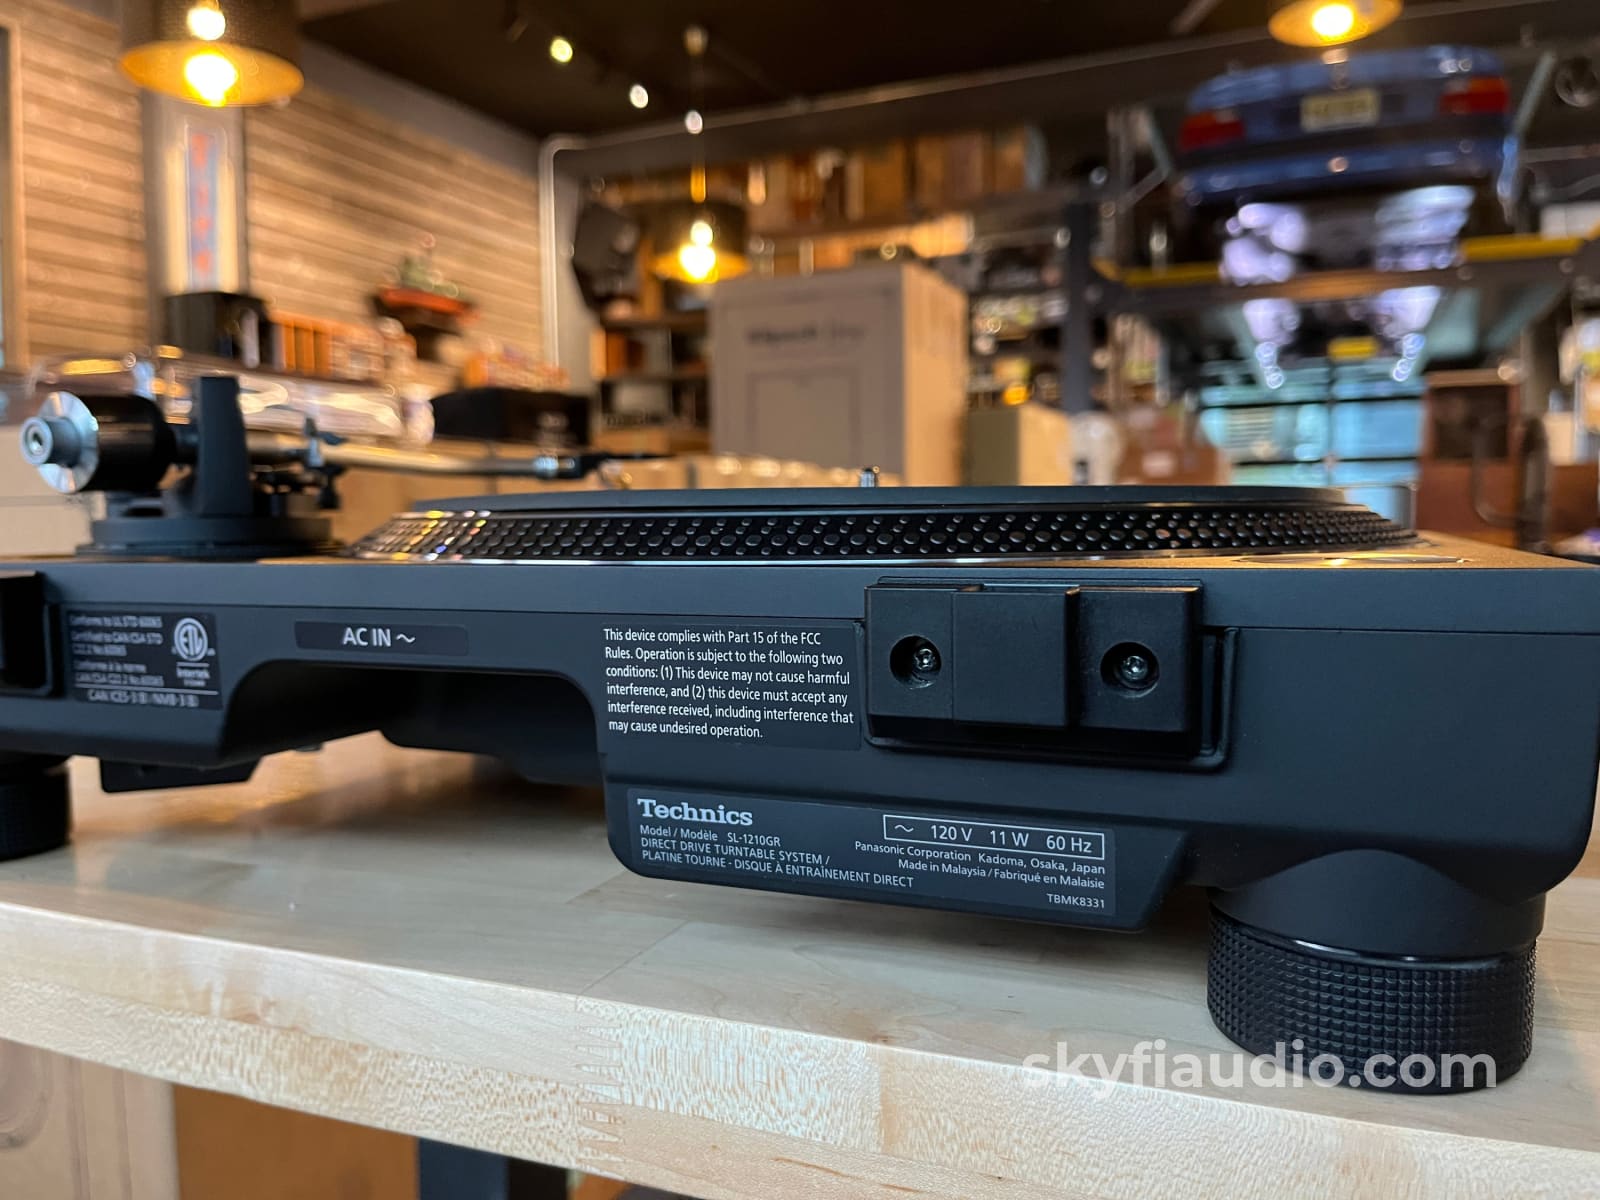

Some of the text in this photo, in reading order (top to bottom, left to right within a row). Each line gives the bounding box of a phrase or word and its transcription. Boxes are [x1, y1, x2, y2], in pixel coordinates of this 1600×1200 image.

[343, 627, 391, 647] AC IN
[604, 628, 821, 645] This device complies with Part 15 of the FCC
[605, 647, 843, 667] Rules. Operation is subject to the following two
[606, 665, 850, 684] conditions: (1) This device may not cause harmful
[607, 683, 847, 706] interference, and (2) this device must accept any
[608, 701, 854, 723] interference received, including interference that
[609, 720, 763, 738] may cause undesired operation.
[637, 798, 753, 826] Technics
[640, 825, 671, 837] Model
[681, 828, 718, 841] Modèle
[727, 832, 781, 847] SL-1210GR
[931, 824, 1092, 853] 120 V 11 W 60 Hz
[641, 838, 676, 851] DIRECT
[680, 841, 711, 854] DRIVE
[714, 843, 775, 859] TURNTABLE
[779, 850, 822, 864] SYSTEM
[855, 841, 1105, 875] Panasonic Corporation Kadoma, Osaka, Japan
[642, 851, 682, 863] PLATINE
[685, 854, 727, 868] TOURNE
[735, 859, 772, 873] DISQUE
[775, 860, 783, 873] À
[786, 866, 870, 883] ENTRAÎNEMENT
[873, 873, 914, 888] DIRECT
[898, 859, 927, 871] Made
[930, 861, 939, 872] in
[941, 863, 985, 878] Malaysia
[994, 868, 1041, 884] Fabriqué
[1043, 875, 1057, 884] en
[1060, 874, 1105, 889] Malaisie
[1047, 893, 1105, 908] TBMK8331
